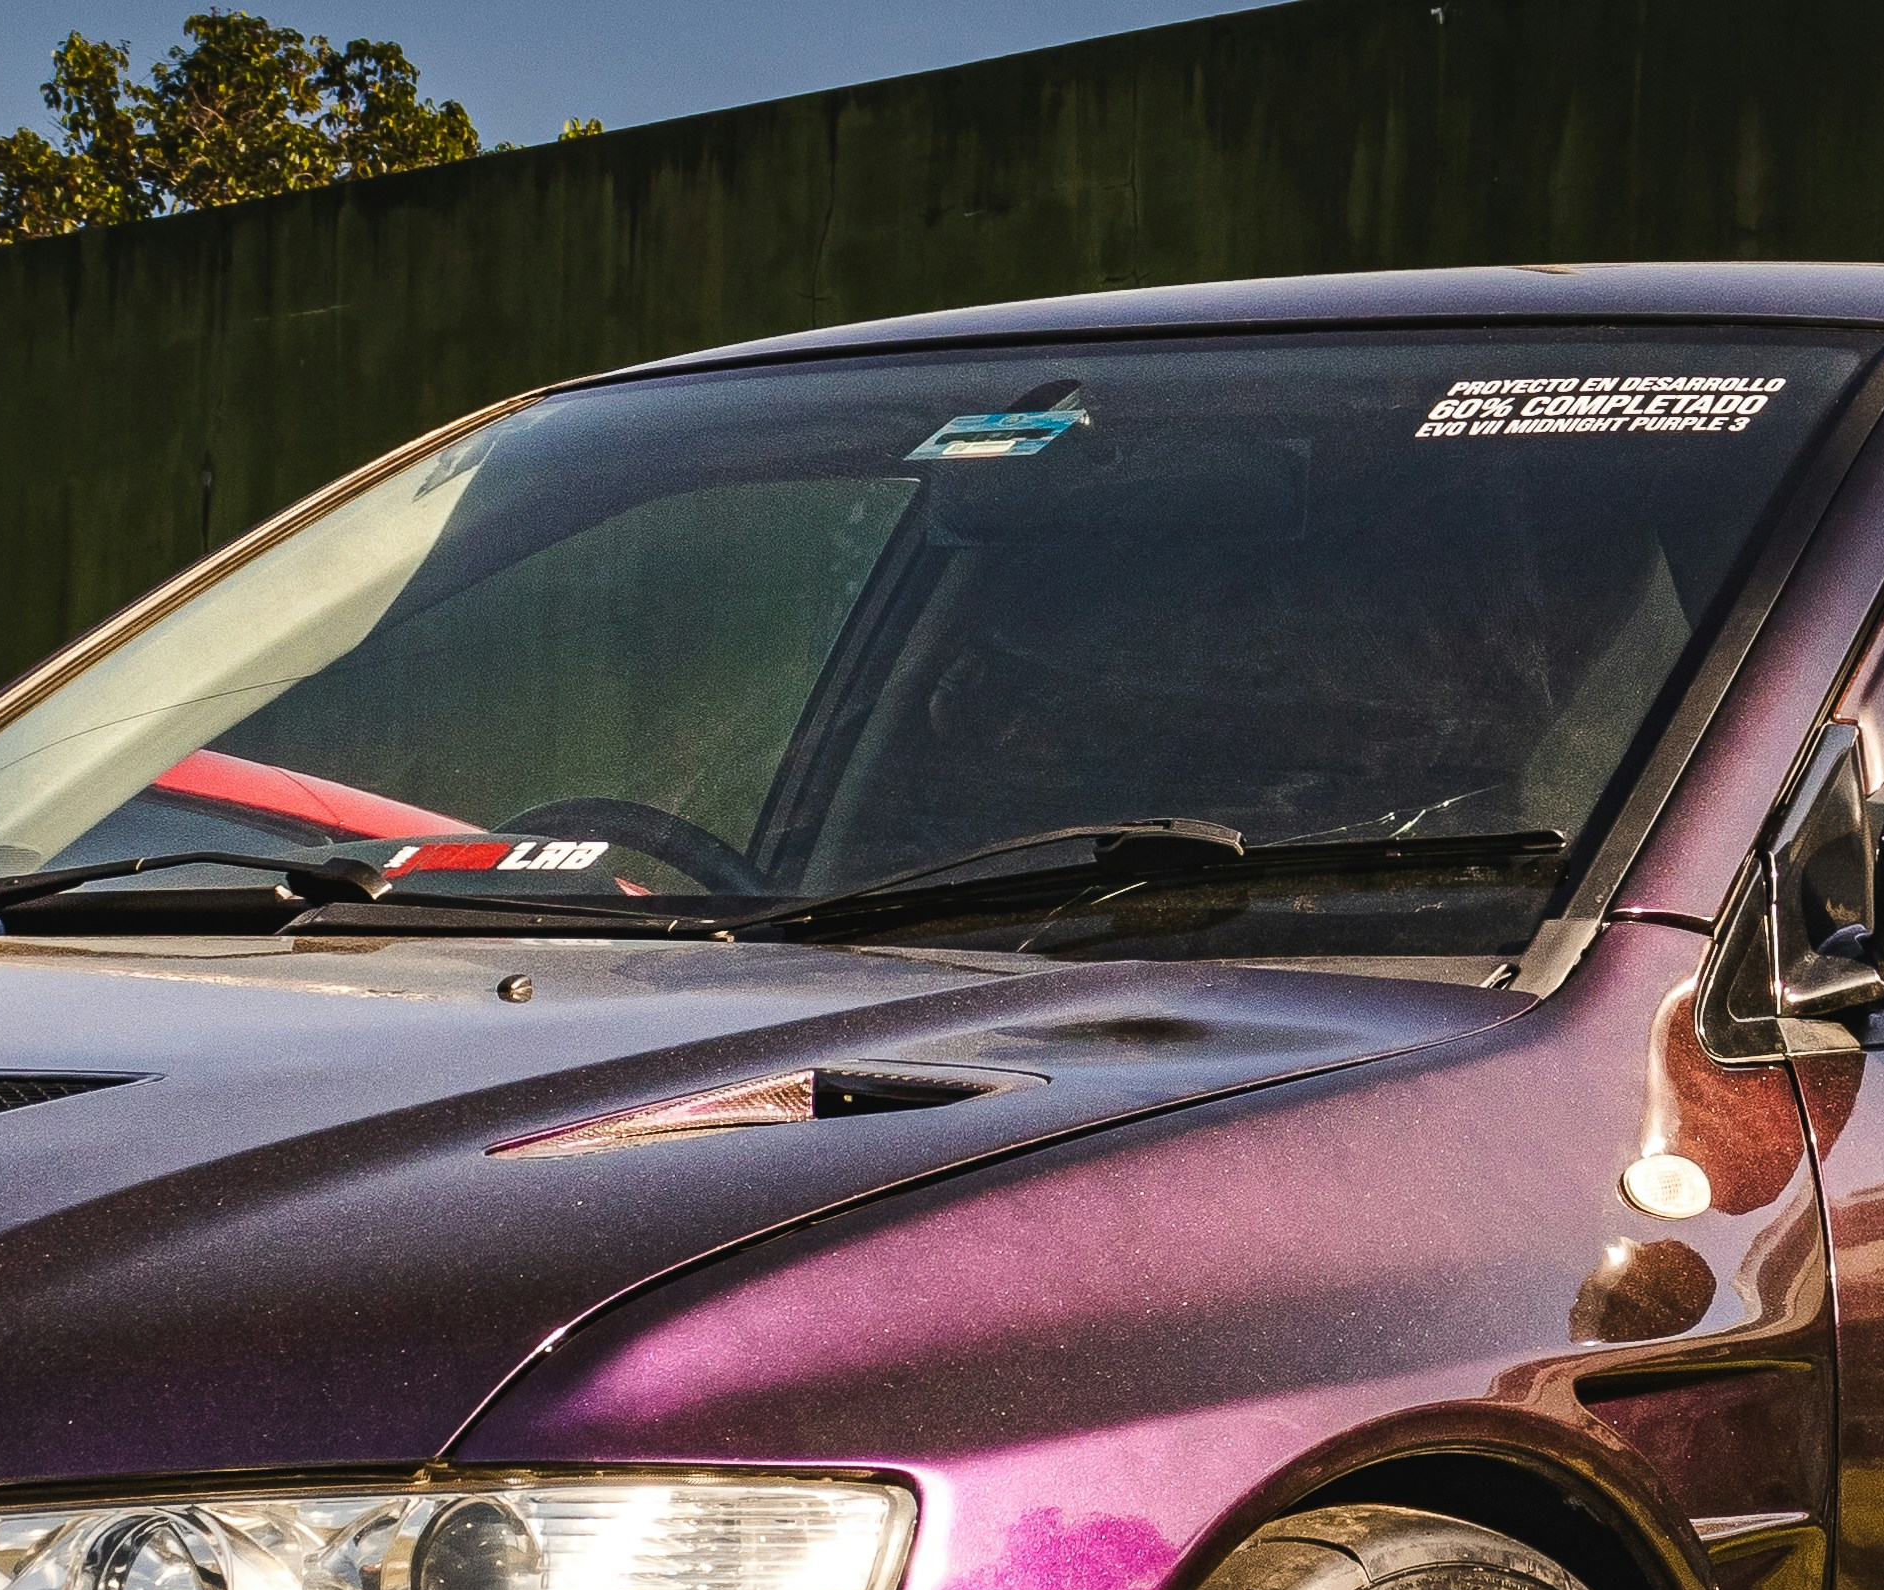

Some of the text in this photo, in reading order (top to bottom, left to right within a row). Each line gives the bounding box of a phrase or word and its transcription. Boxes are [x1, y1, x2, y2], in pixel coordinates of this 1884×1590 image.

[1446, 377, 1786, 397] PROYECTO EN DESARROLLO
[1427, 395, 1769, 420] 60% COMPLETADO
[1415, 417, 1750, 437] EVO VII MIDNIGHT PURPLE 3
[497, 841, 609, 871] LAB
